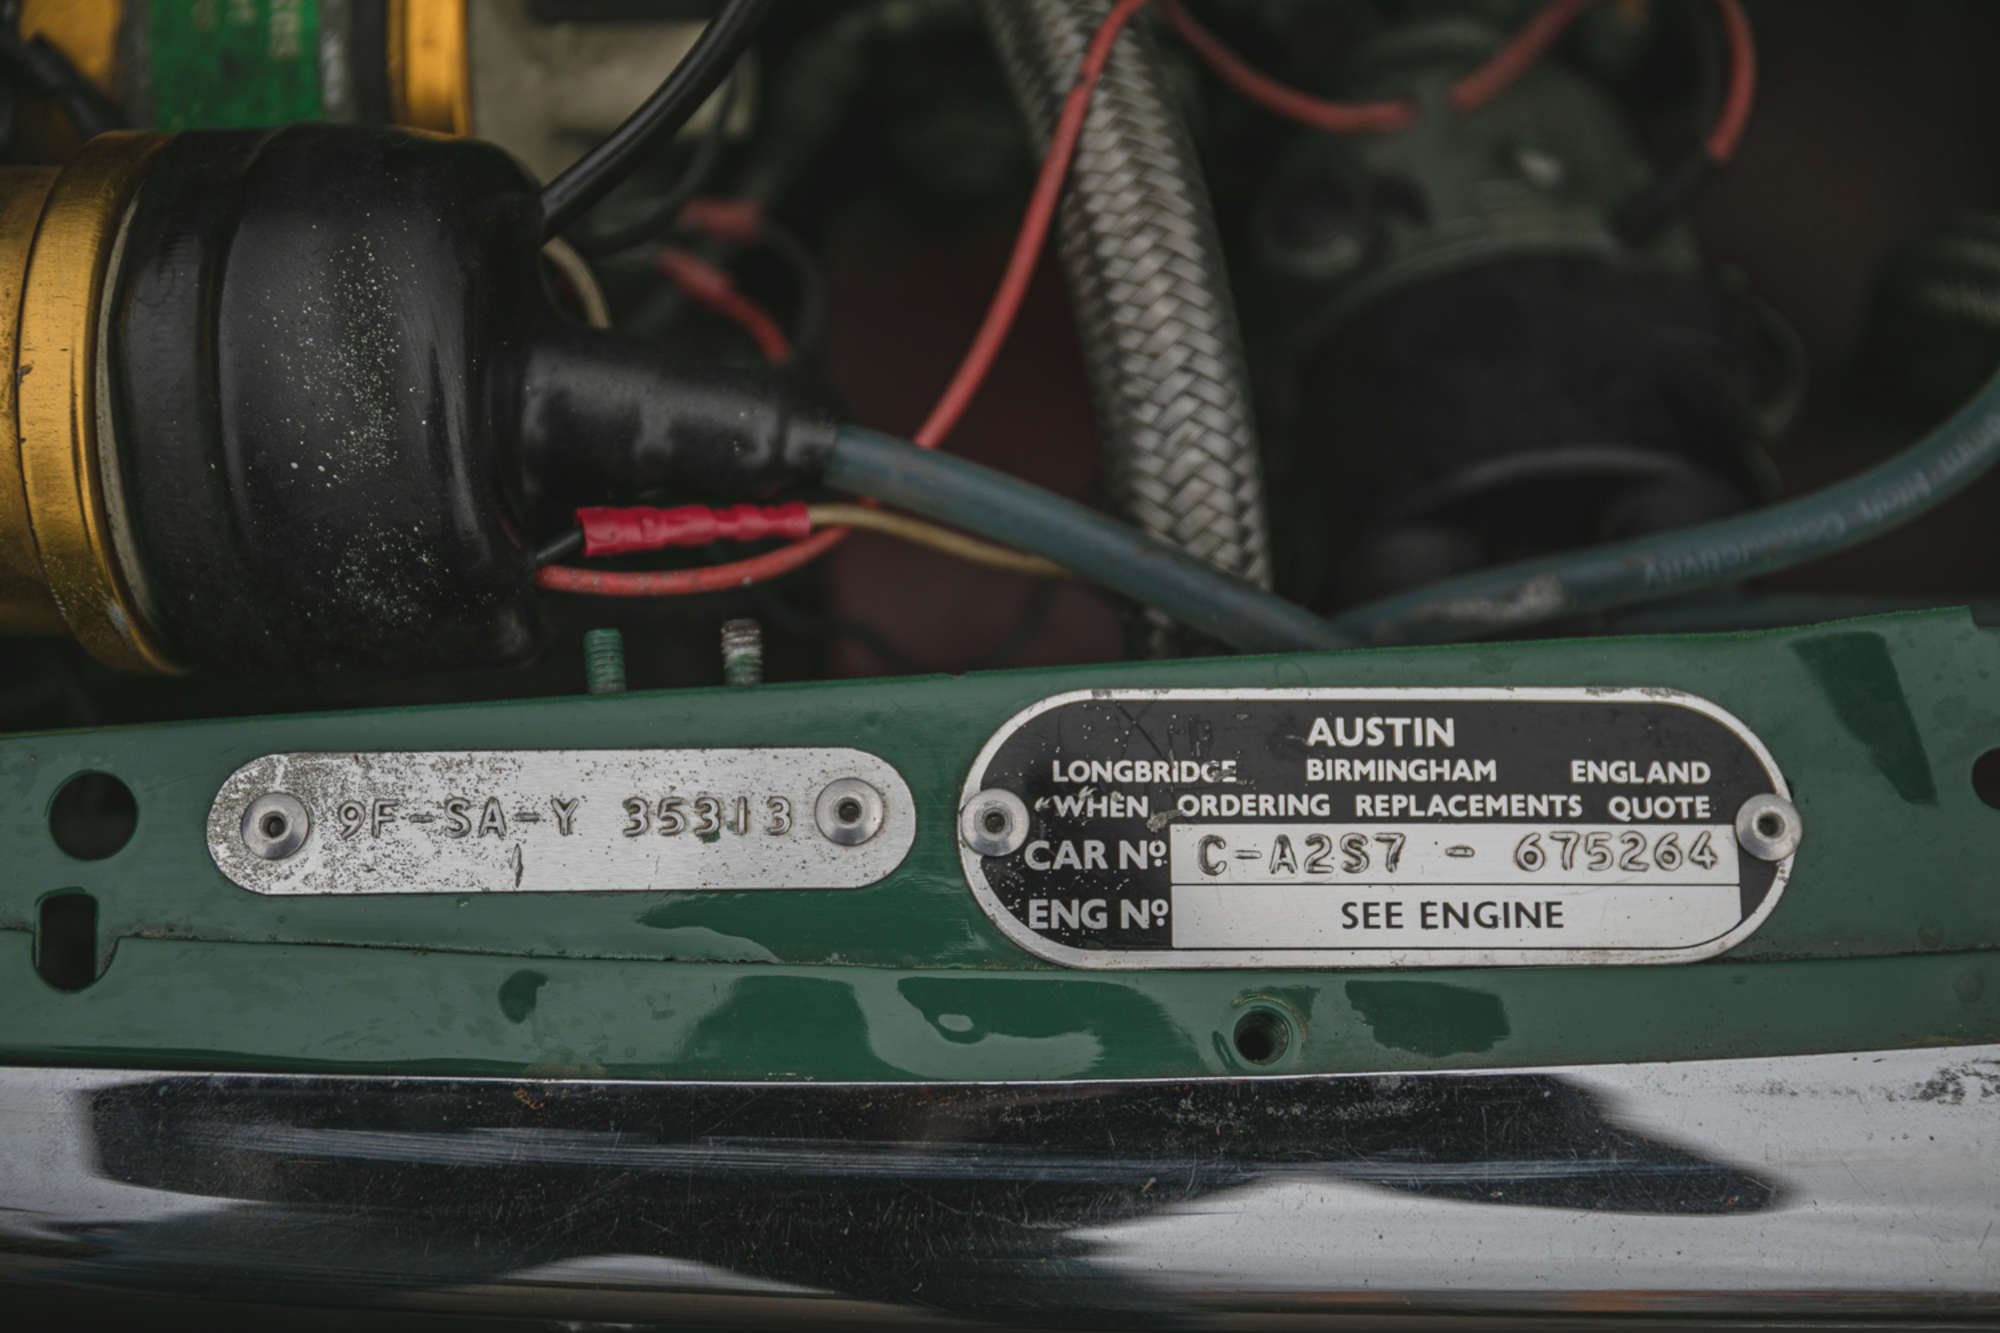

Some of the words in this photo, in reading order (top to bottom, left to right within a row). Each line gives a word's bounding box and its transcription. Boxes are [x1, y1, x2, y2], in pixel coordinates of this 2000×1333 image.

[1306, 717, 1456, 748] AUSTIN
[1052, 759, 1238, 784] LONGBRIDGE
[1306, 758, 1498, 783] BIRMINGHAM
[1570, 759, 1712, 785] ENGLAND
[621, 795, 793, 838] 35313
[1052, 794, 1150, 818] WHEN
[1177, 793, 1331, 817] ORDERING
[1356, 793, 1583, 818] REPLACEMENTS
[1608, 794, 1712, 822] QUOTE
[1024, 839, 1108, 871] CAR
[1513, 830, 1719, 873] 675264
[1028, 898, 1108, 930] ENG
[1341, 901, 1404, 930] SEE
[1420, 900, 1565, 929] ENGINE
